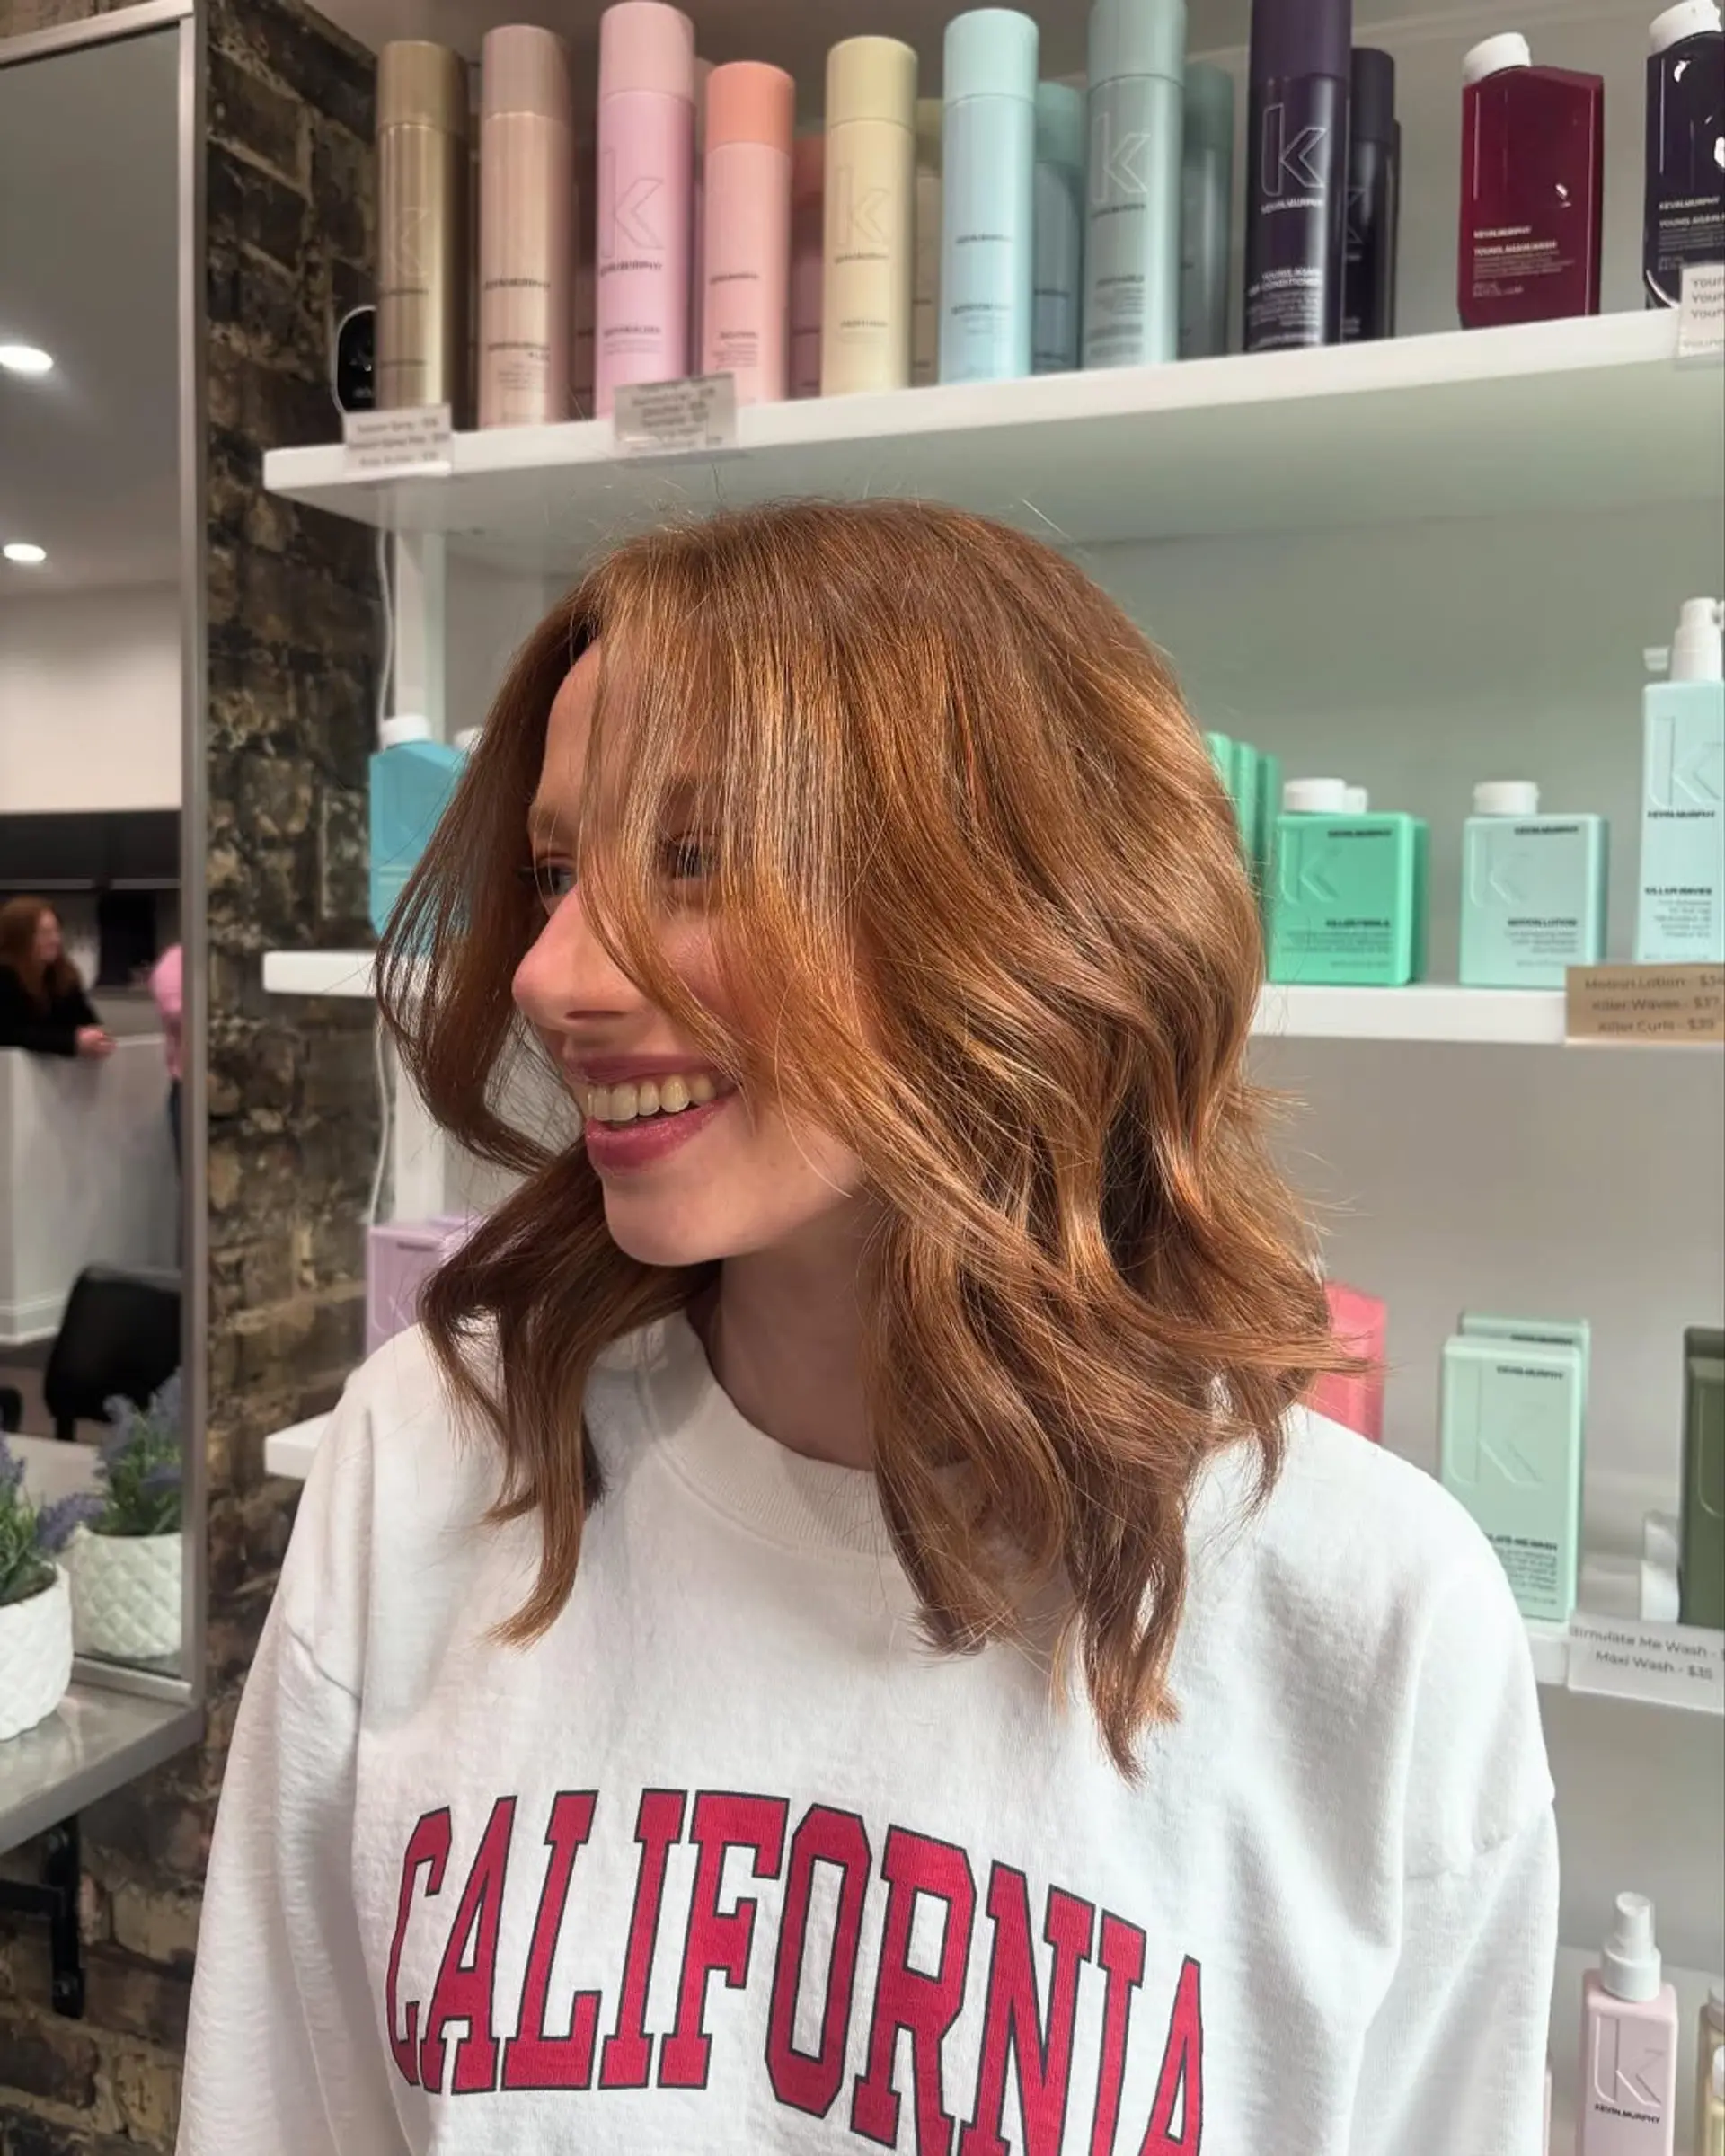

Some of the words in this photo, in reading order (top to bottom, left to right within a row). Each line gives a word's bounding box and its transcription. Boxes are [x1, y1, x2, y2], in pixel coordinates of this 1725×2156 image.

[1639, 1635, 1662, 1649] Me
[1666, 1639, 1707, 1657] Wash
[1632, 1656, 1675, 1674] Wash
[385, 1788, 1202, 2156] CALIFORNIA
